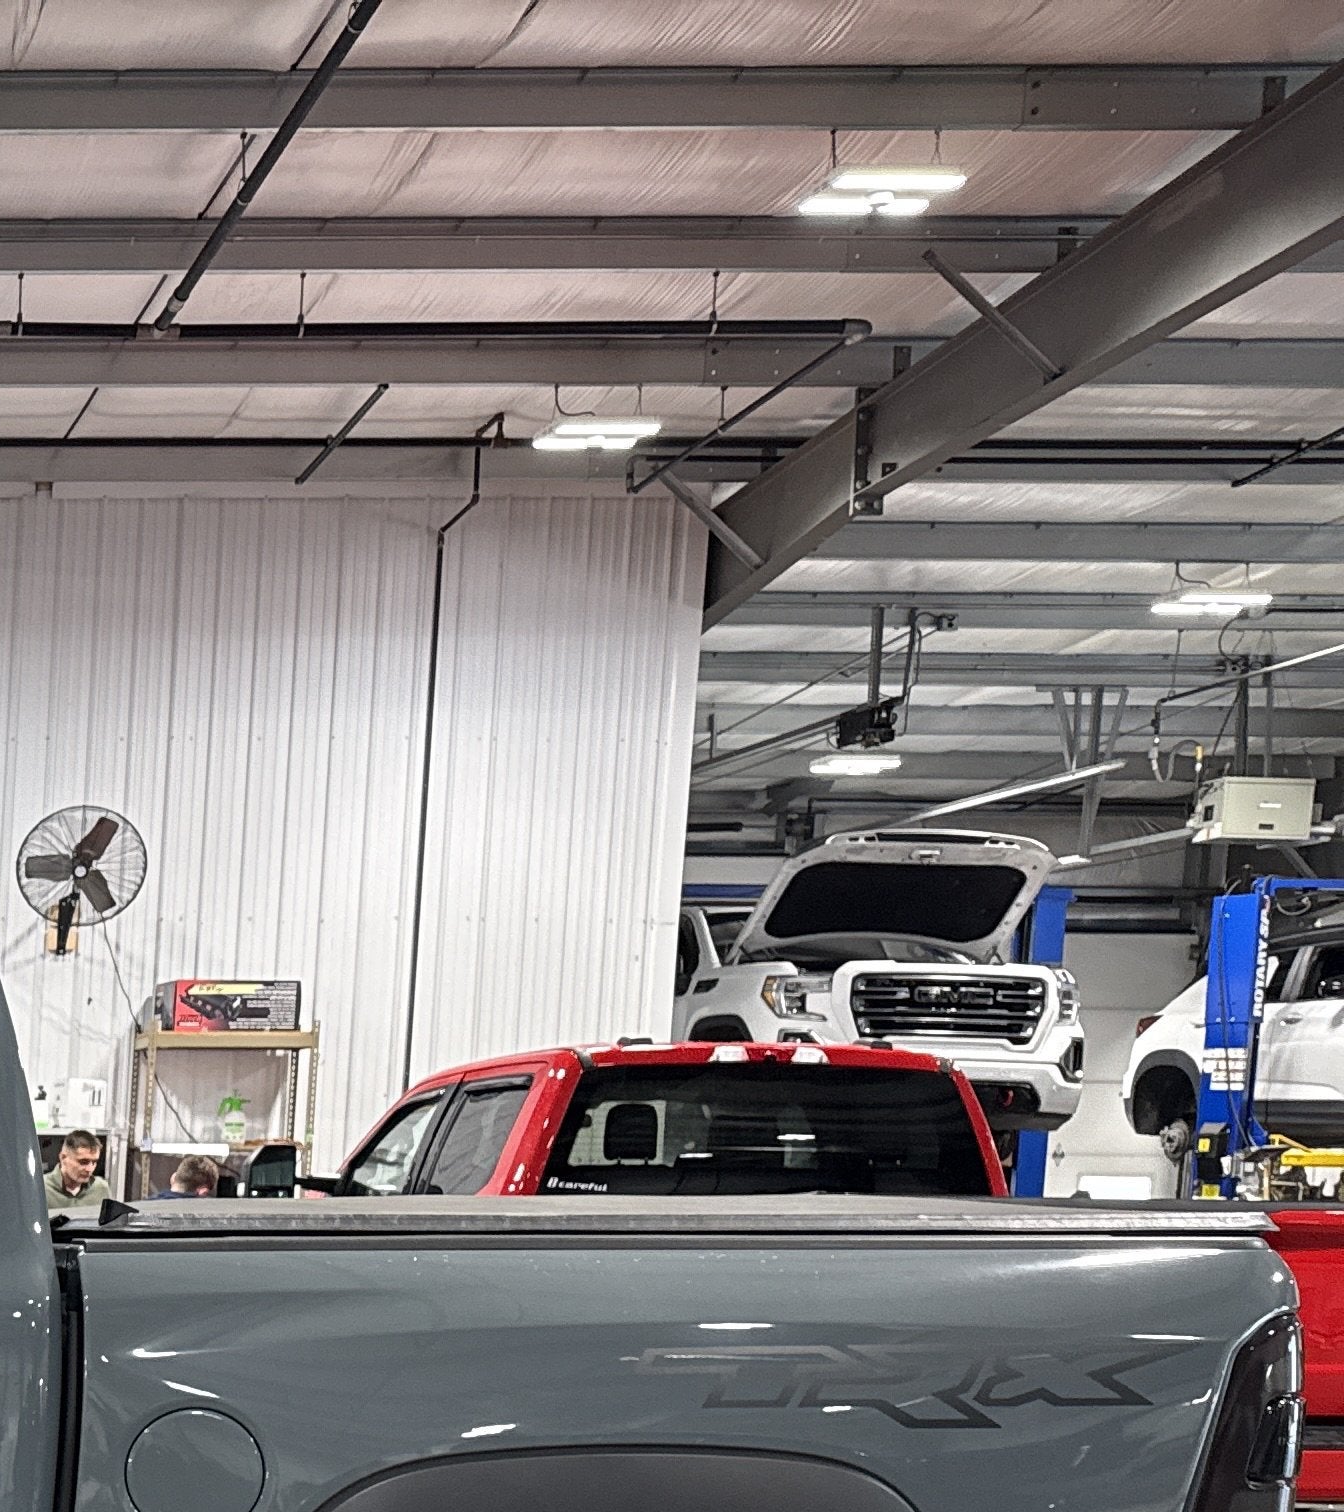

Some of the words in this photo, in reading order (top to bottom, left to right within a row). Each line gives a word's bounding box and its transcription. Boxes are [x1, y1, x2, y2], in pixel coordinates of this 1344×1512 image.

[914, 985, 995, 1005] GMC
[1252, 938, 1268, 1018] ROTARY
[633, 1343, 1200, 1429] TRX
